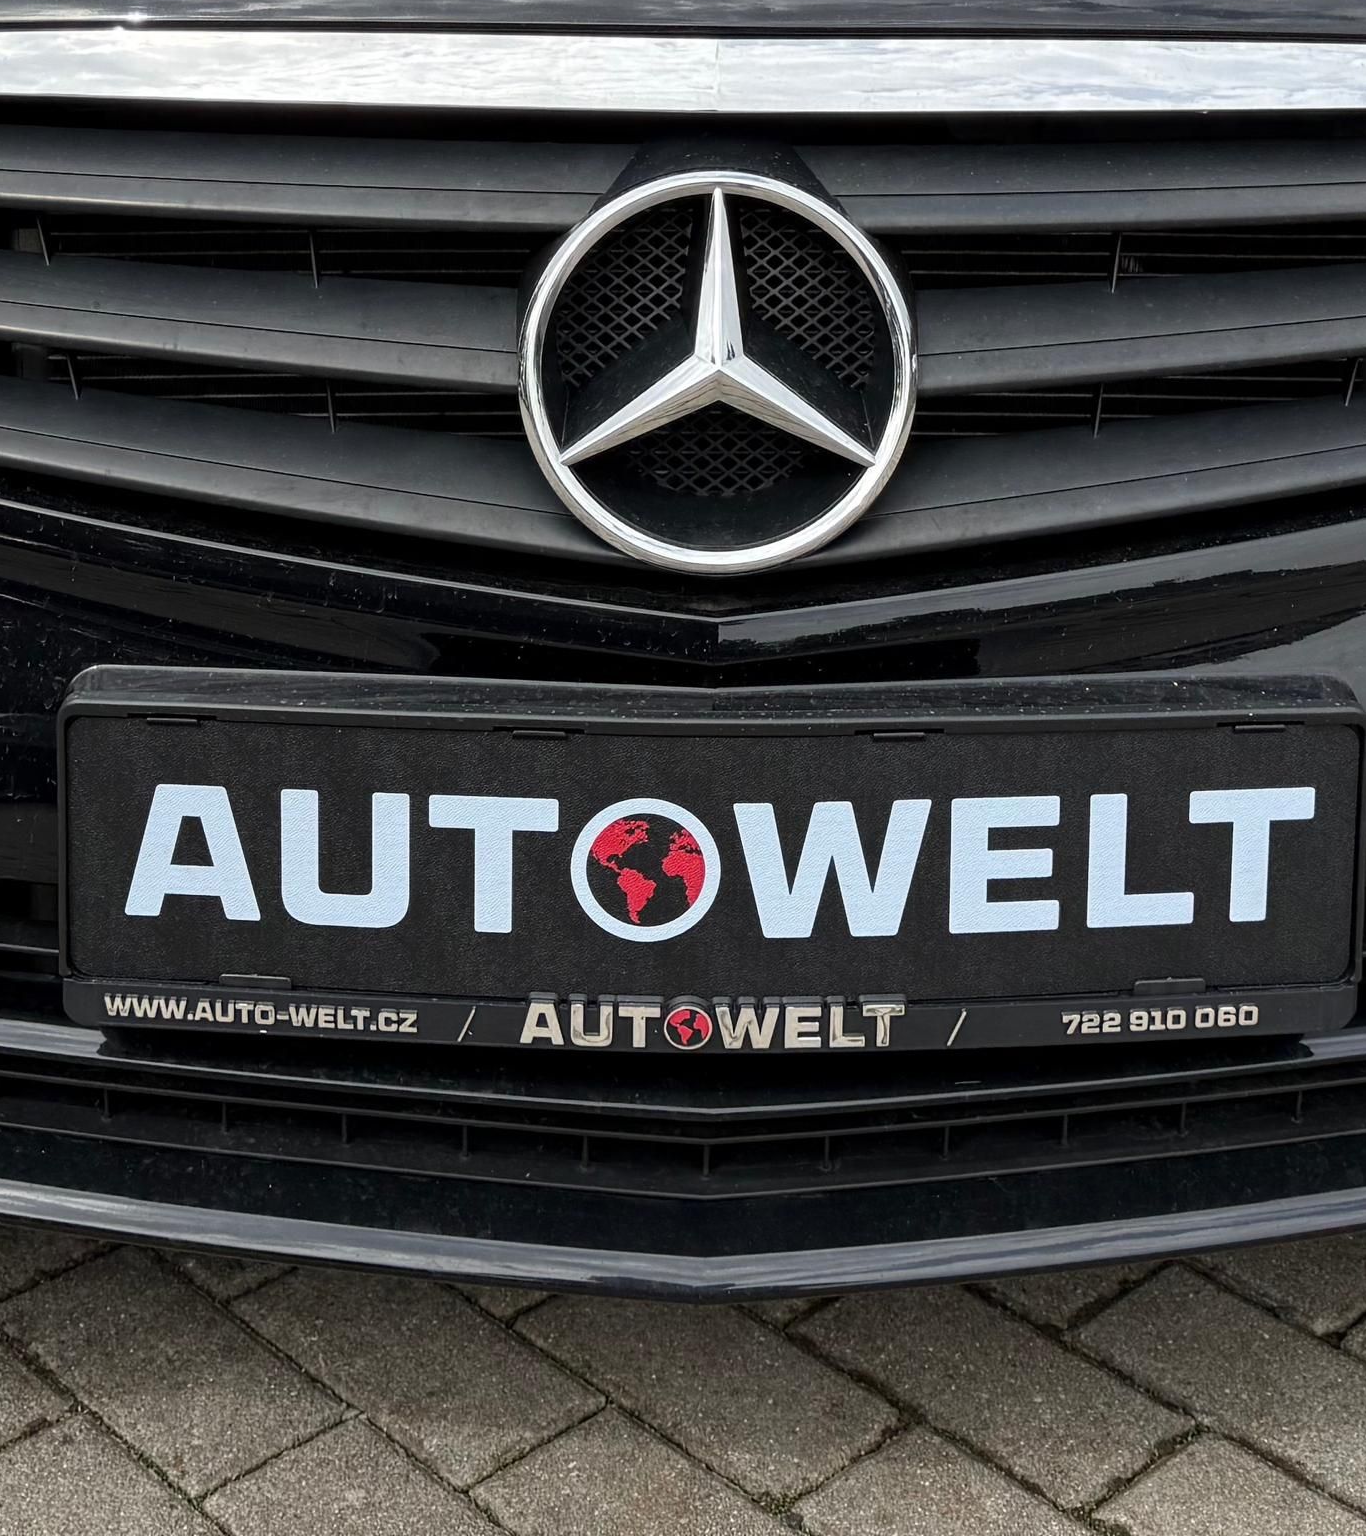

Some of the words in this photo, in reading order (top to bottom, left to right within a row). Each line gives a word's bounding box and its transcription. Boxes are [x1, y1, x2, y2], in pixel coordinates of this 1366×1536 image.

[104, 993, 418, 1033] WWW.AUTO-WELT.CZ
[1061, 1012, 1121, 1035] 722
[1129, 1009, 1186, 1031] 910
[1194, 1004, 1259, 1028] 060
